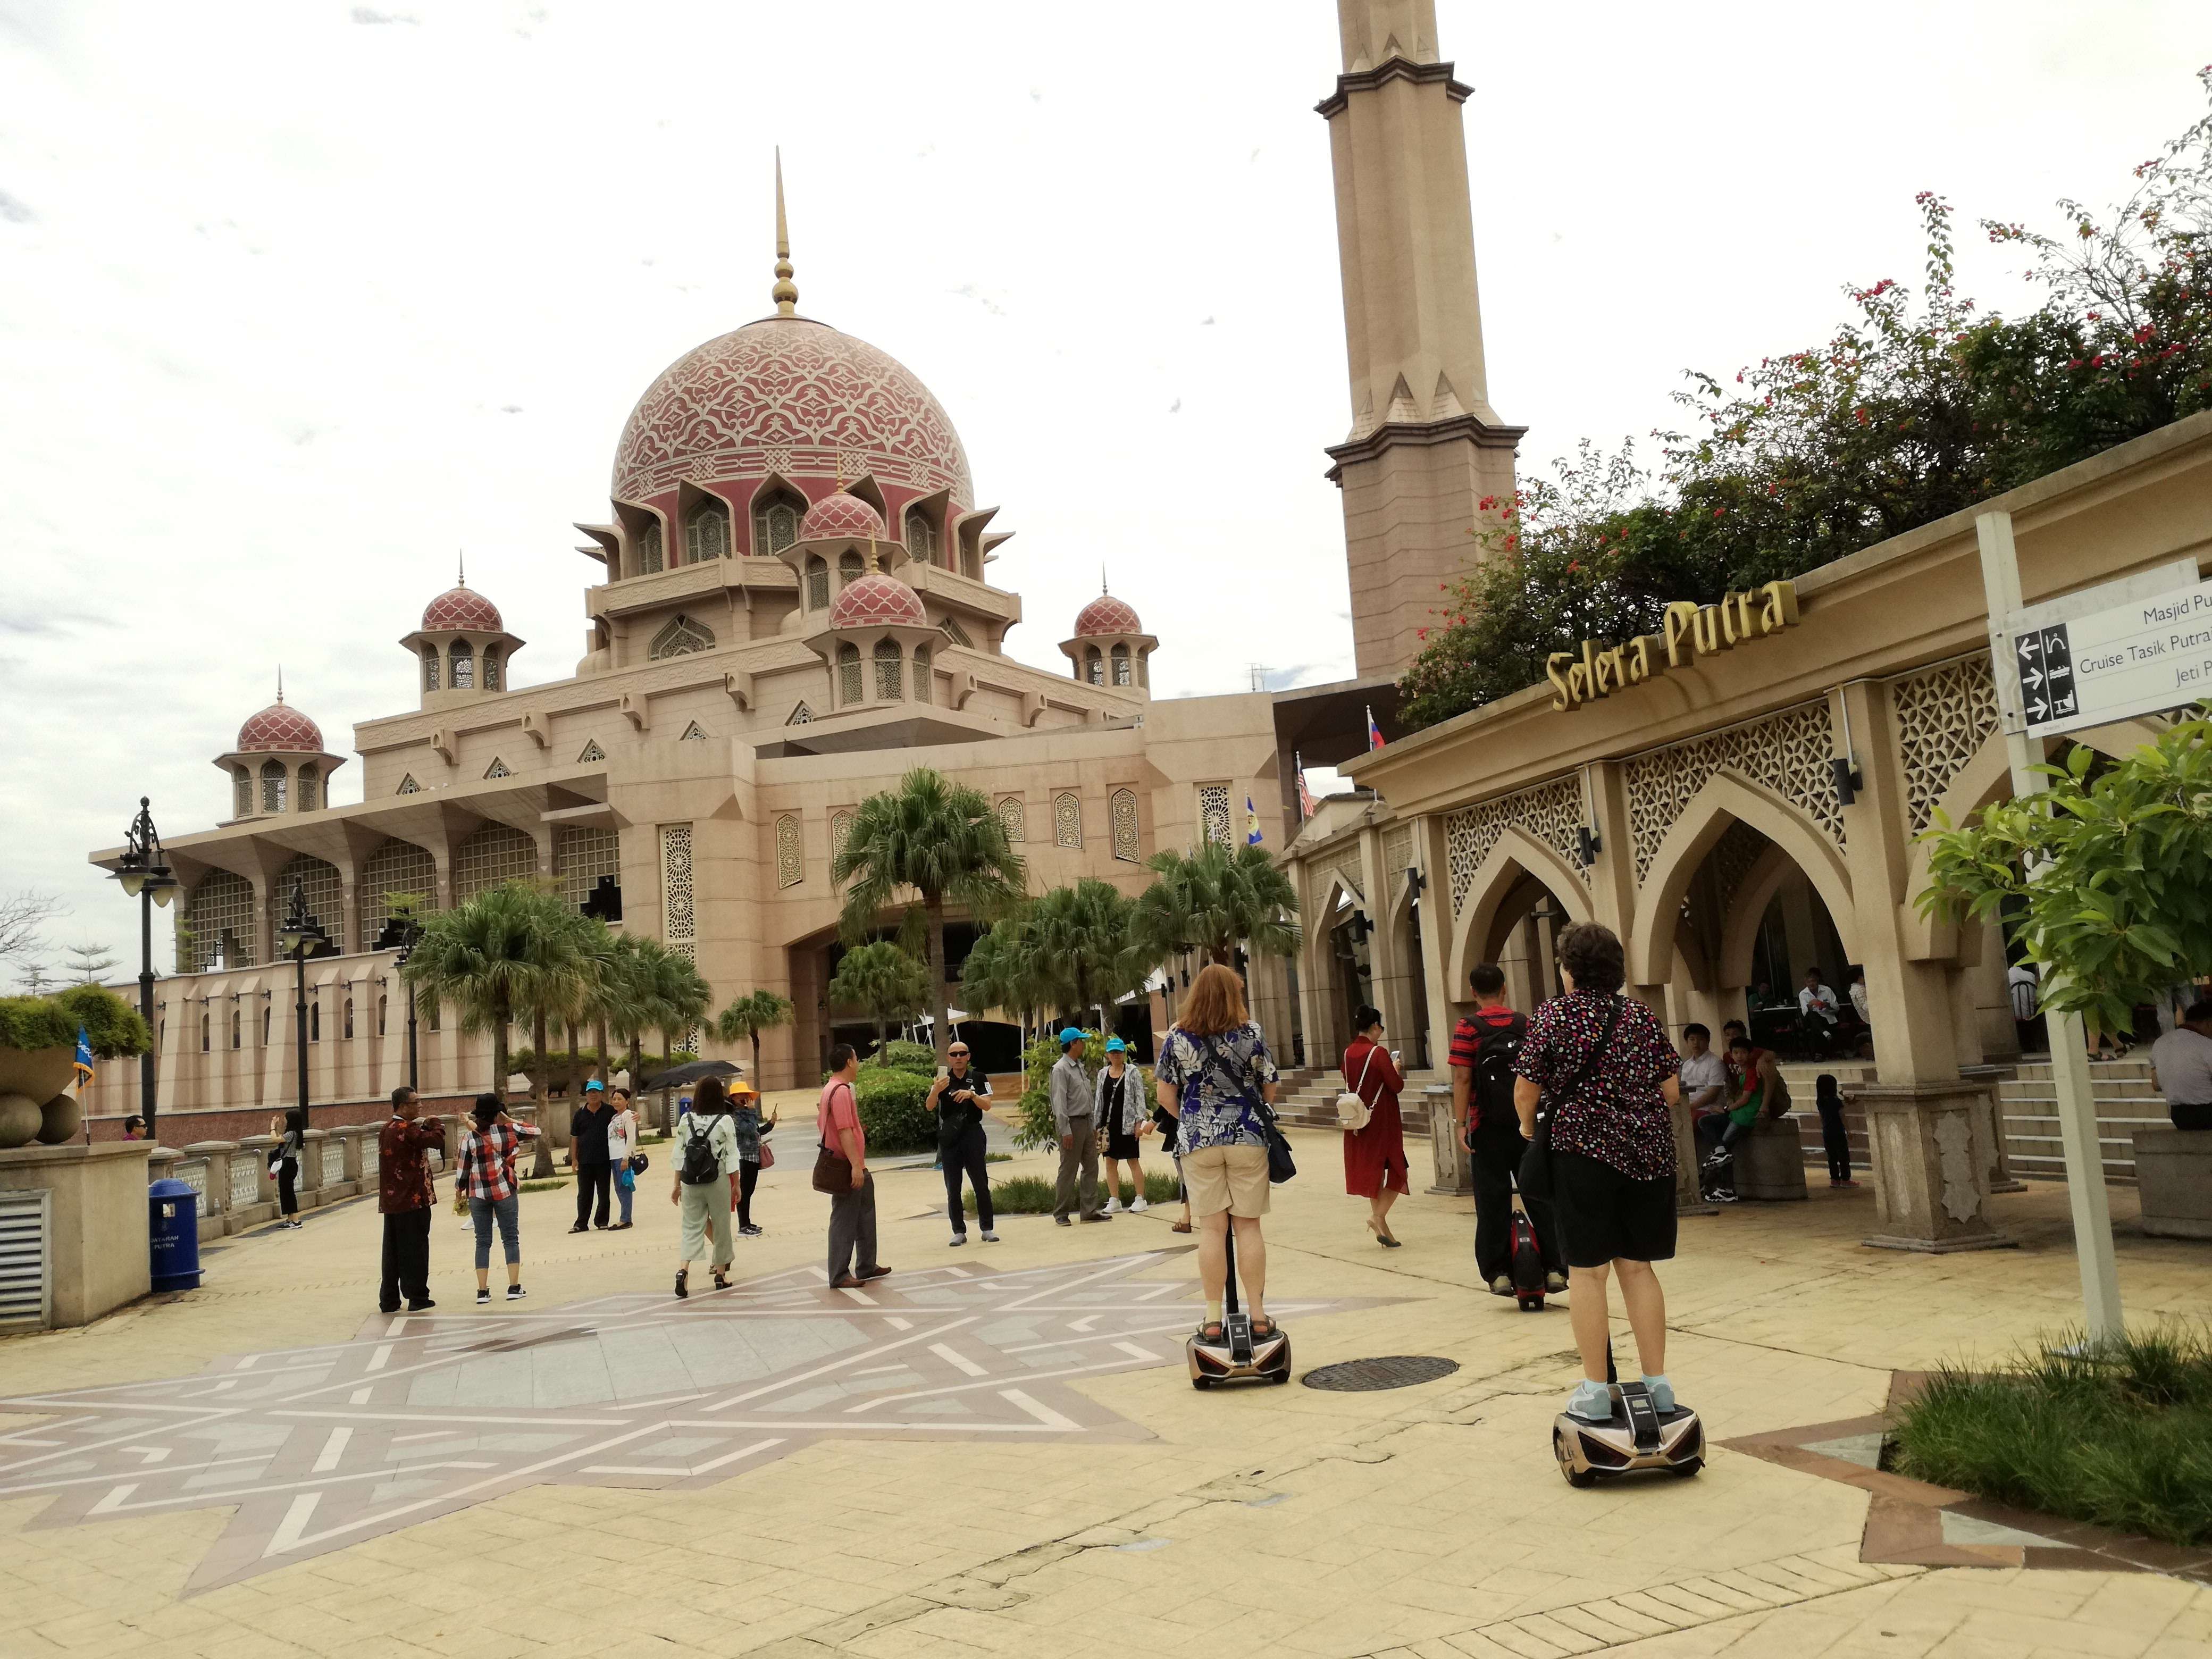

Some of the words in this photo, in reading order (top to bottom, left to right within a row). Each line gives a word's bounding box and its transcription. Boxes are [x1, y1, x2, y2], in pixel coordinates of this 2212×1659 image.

[2143, 598, 2189, 625] Masjid
[1546, 635, 1653, 713] Selera
[1662, 580, 1788, 668] Putra
[2080, 655, 2124, 674] Cruise
[2127, 640, 2166, 661] Tasik
[2170, 626, 2212, 651] Putra
[2176, 665, 2199, 688] Jeti
